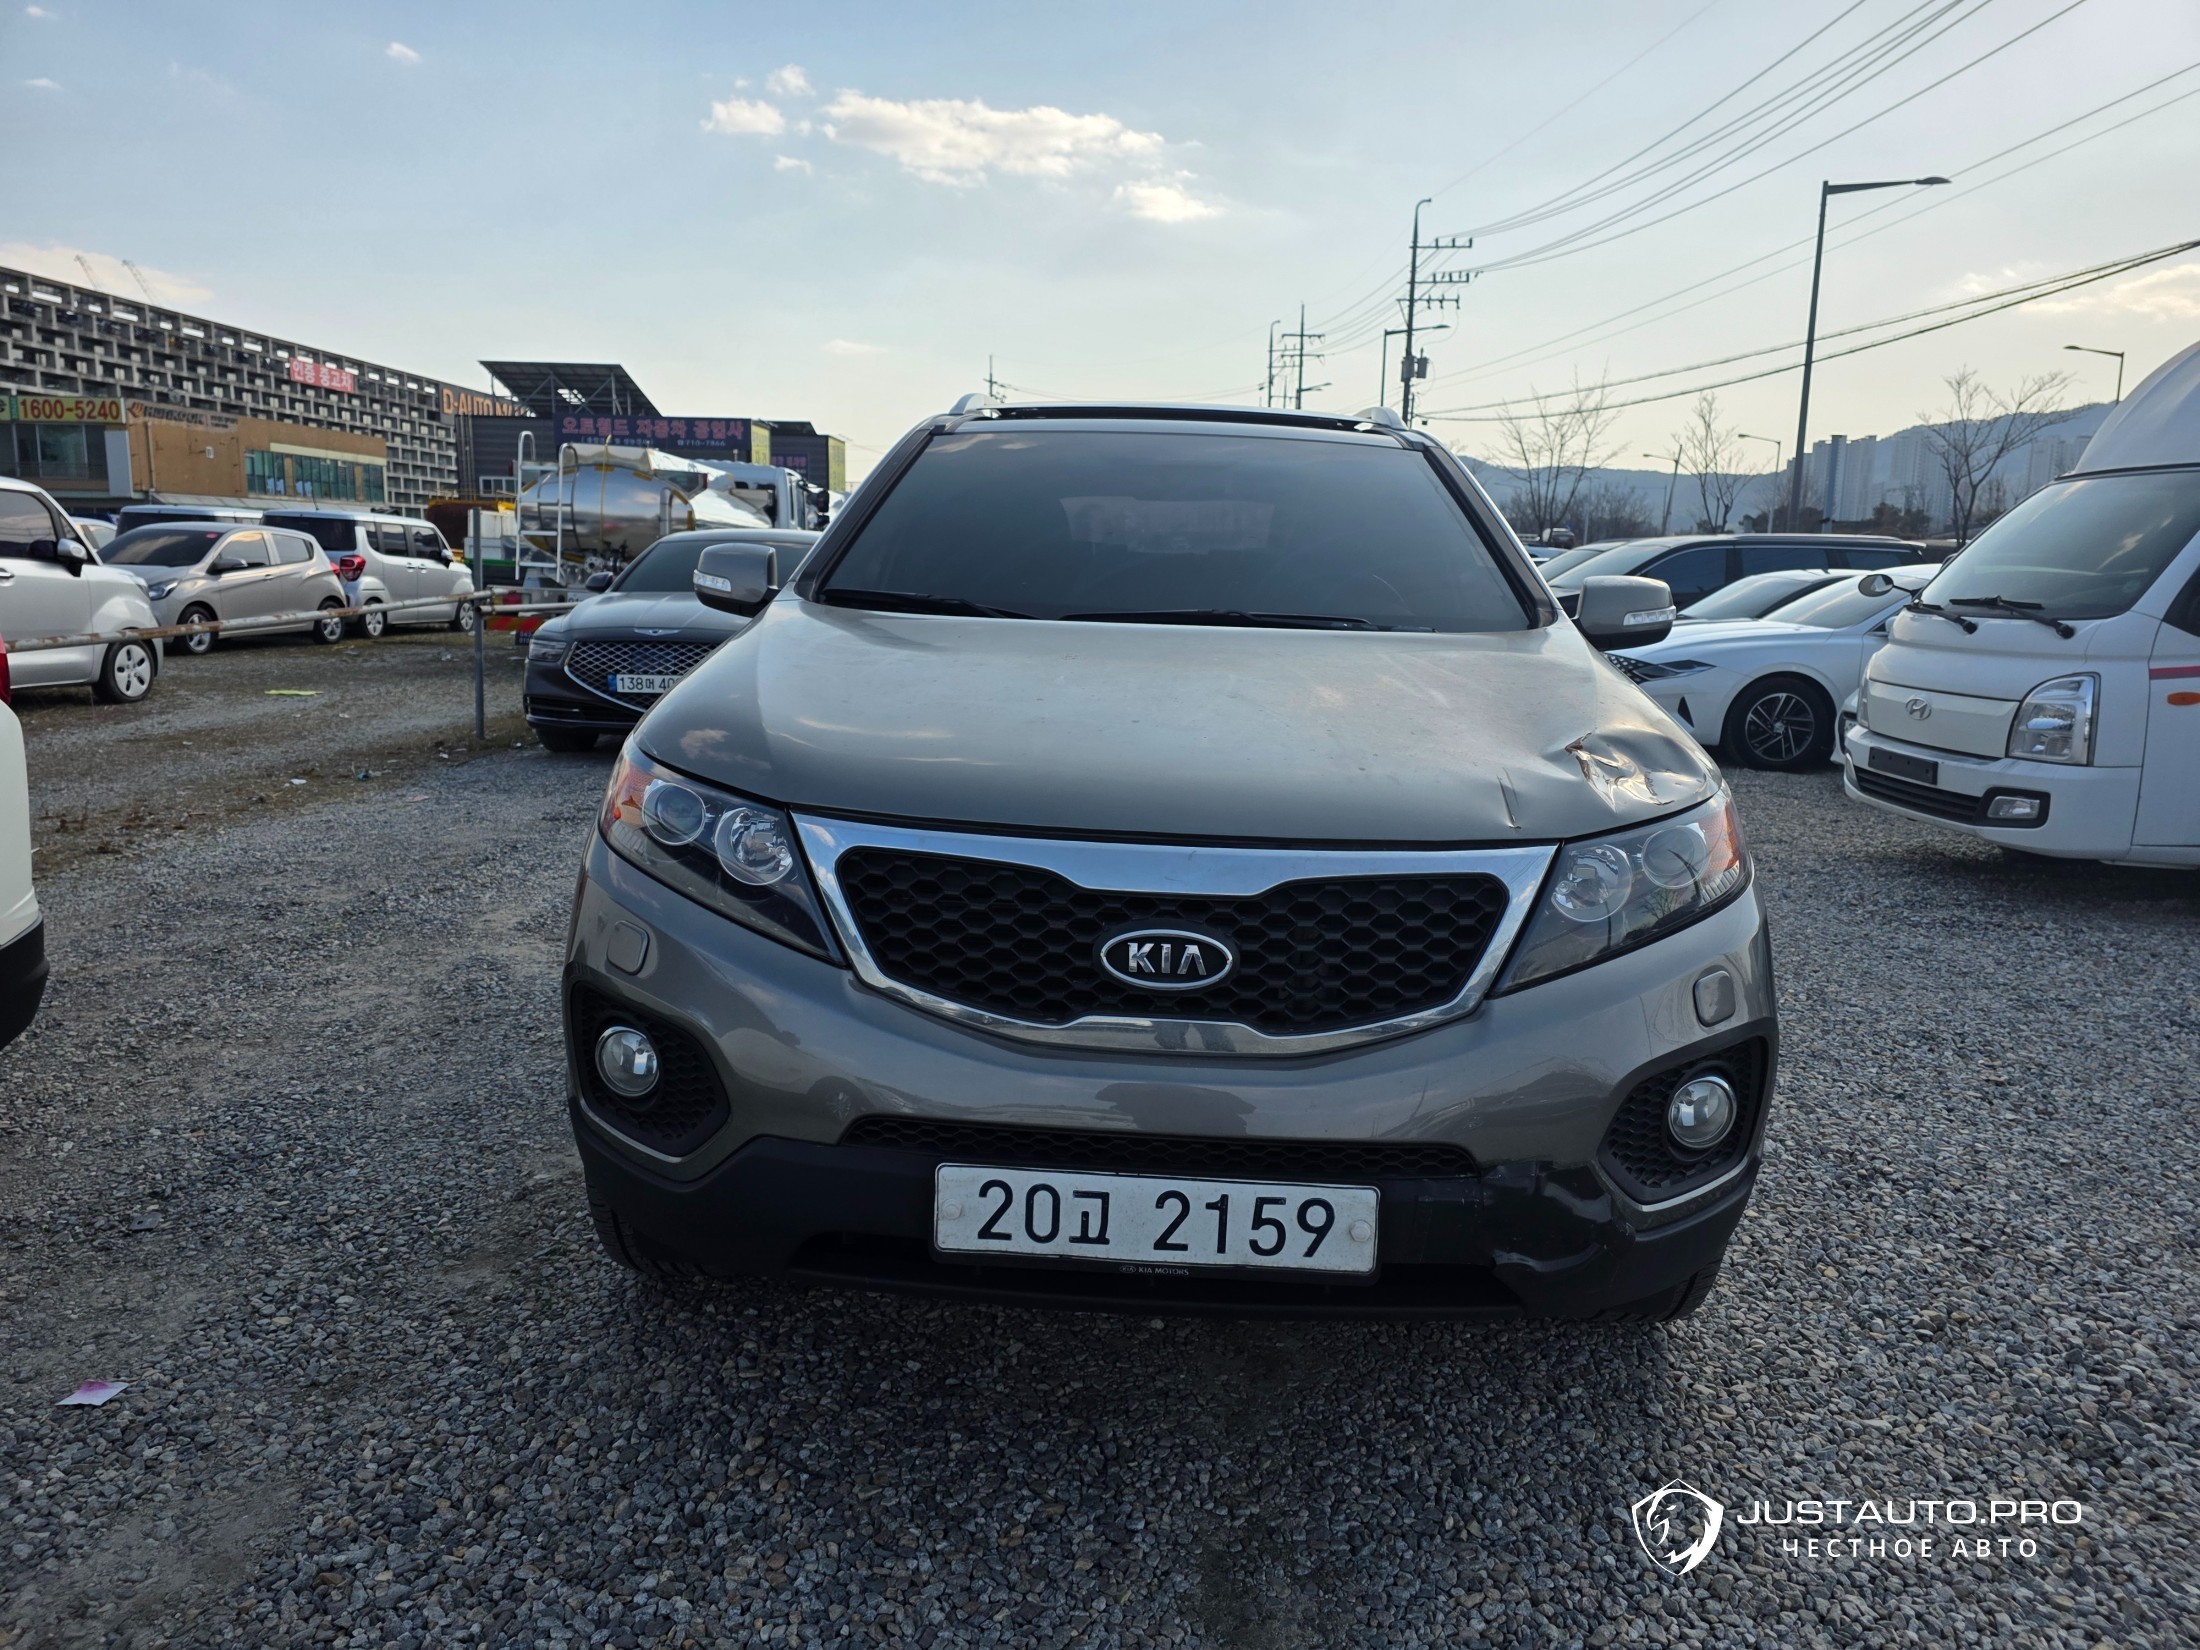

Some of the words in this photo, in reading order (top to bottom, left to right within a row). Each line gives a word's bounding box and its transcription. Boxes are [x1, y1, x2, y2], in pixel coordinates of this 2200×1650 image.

[293, 360, 315, 384] 인증
[319, 366, 352, 393] 중고차
[20, 399, 120, 420] 1600-5240
[636, 418, 686, 439] 자동차
[693, 420, 743, 440] 공업사
[619, 677, 655, 690] 138머
[658, 677, 679, 690] 40
[1127, 942, 1207, 976] KIA
[977, 1179, 1110, 1244] 20고
[1153, 1190, 1336, 1258] 2159
[1139, 1266, 1153, 1274] KIA
[1154, 1267, 1189, 1276] MOTORS
